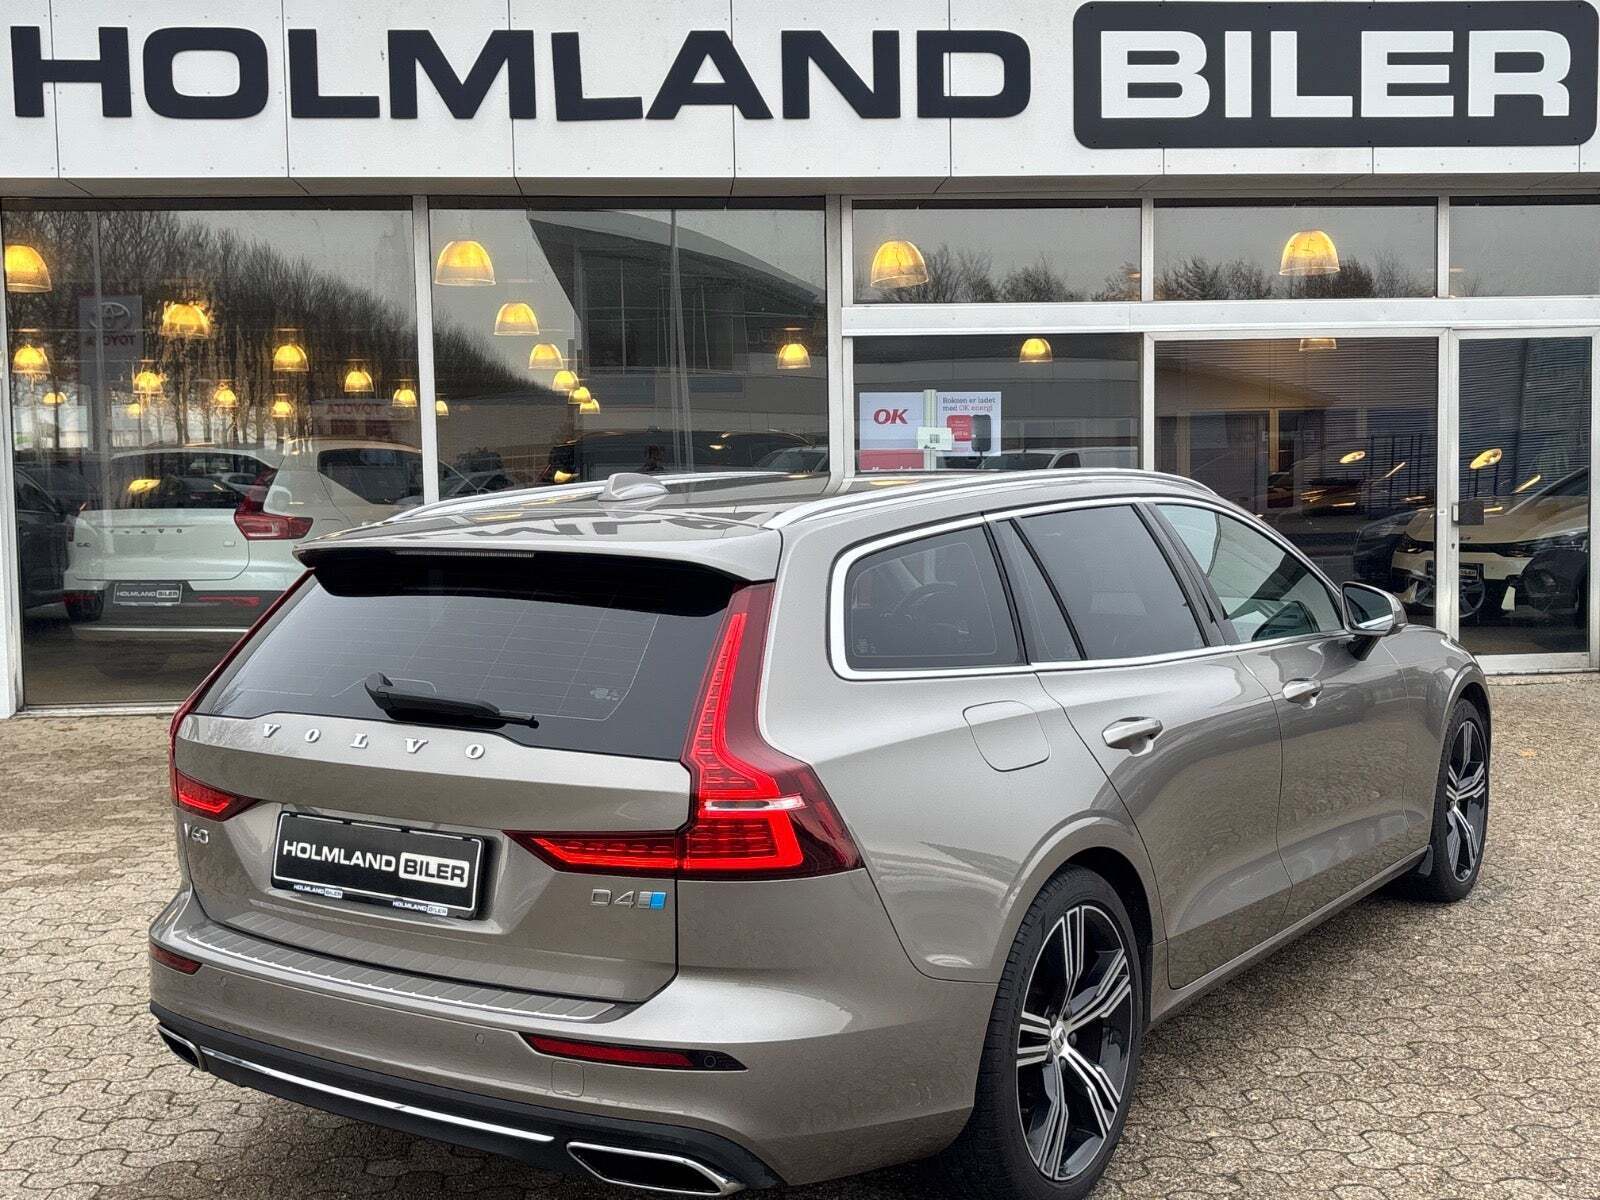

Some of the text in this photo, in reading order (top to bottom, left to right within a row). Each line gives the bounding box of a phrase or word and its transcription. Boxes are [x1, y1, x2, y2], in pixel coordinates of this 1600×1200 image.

[10, 26, 1571, 121] HOLMLAND BILER
[942, 404, 993, 414] med OK energi
[978, 396, 996, 404] ladet
[873, 408, 908, 425] OK
[262, 722, 486, 760] VOLVO
[183, 822, 209, 844] V60
[283, 840, 466, 883] HOLMLAND BILER
[294, 884, 342, 898] HOLMLAND BILER
[591, 888, 635, 909] D4
[392, 900, 447, 915] HOLMLAND BILER
